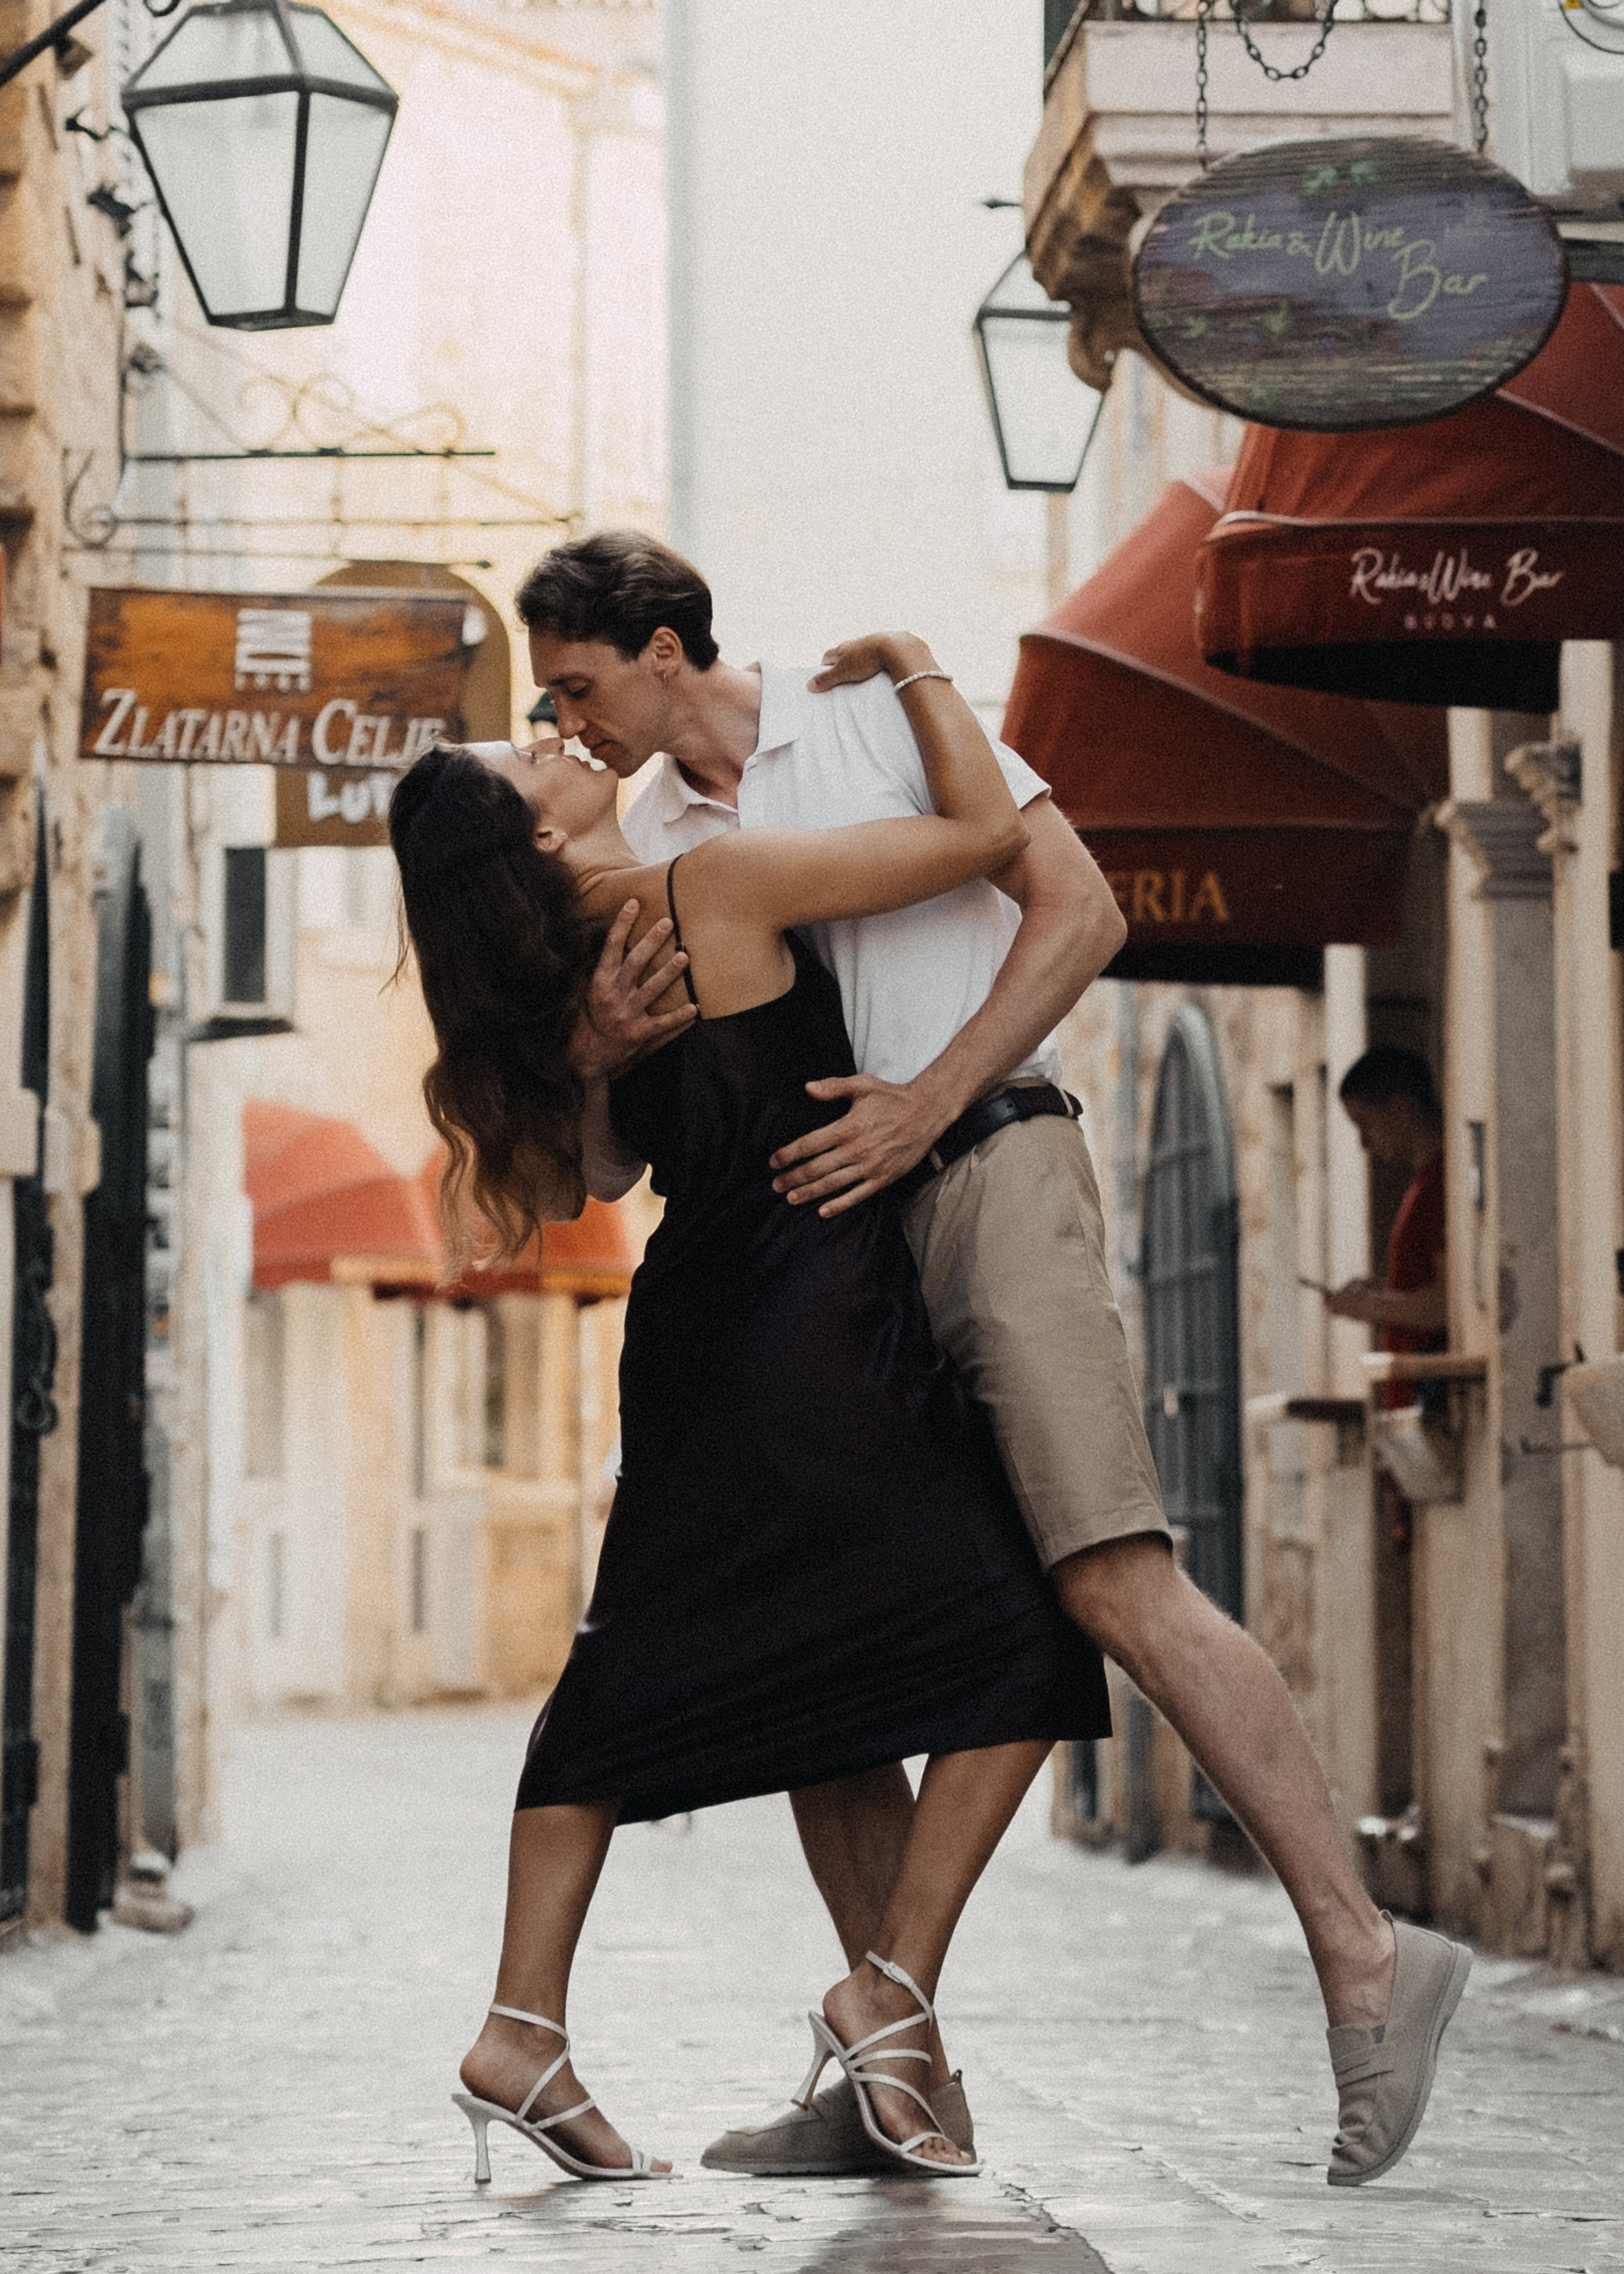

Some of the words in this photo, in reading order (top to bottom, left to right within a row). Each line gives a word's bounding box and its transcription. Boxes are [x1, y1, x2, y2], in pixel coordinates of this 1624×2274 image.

[1314, 210, 1406, 276] Wine
[1387, 239, 1487, 320] Bar
[1499, 547, 1565, 607] Bar
[94, 688, 301, 764] ZLATARNA
